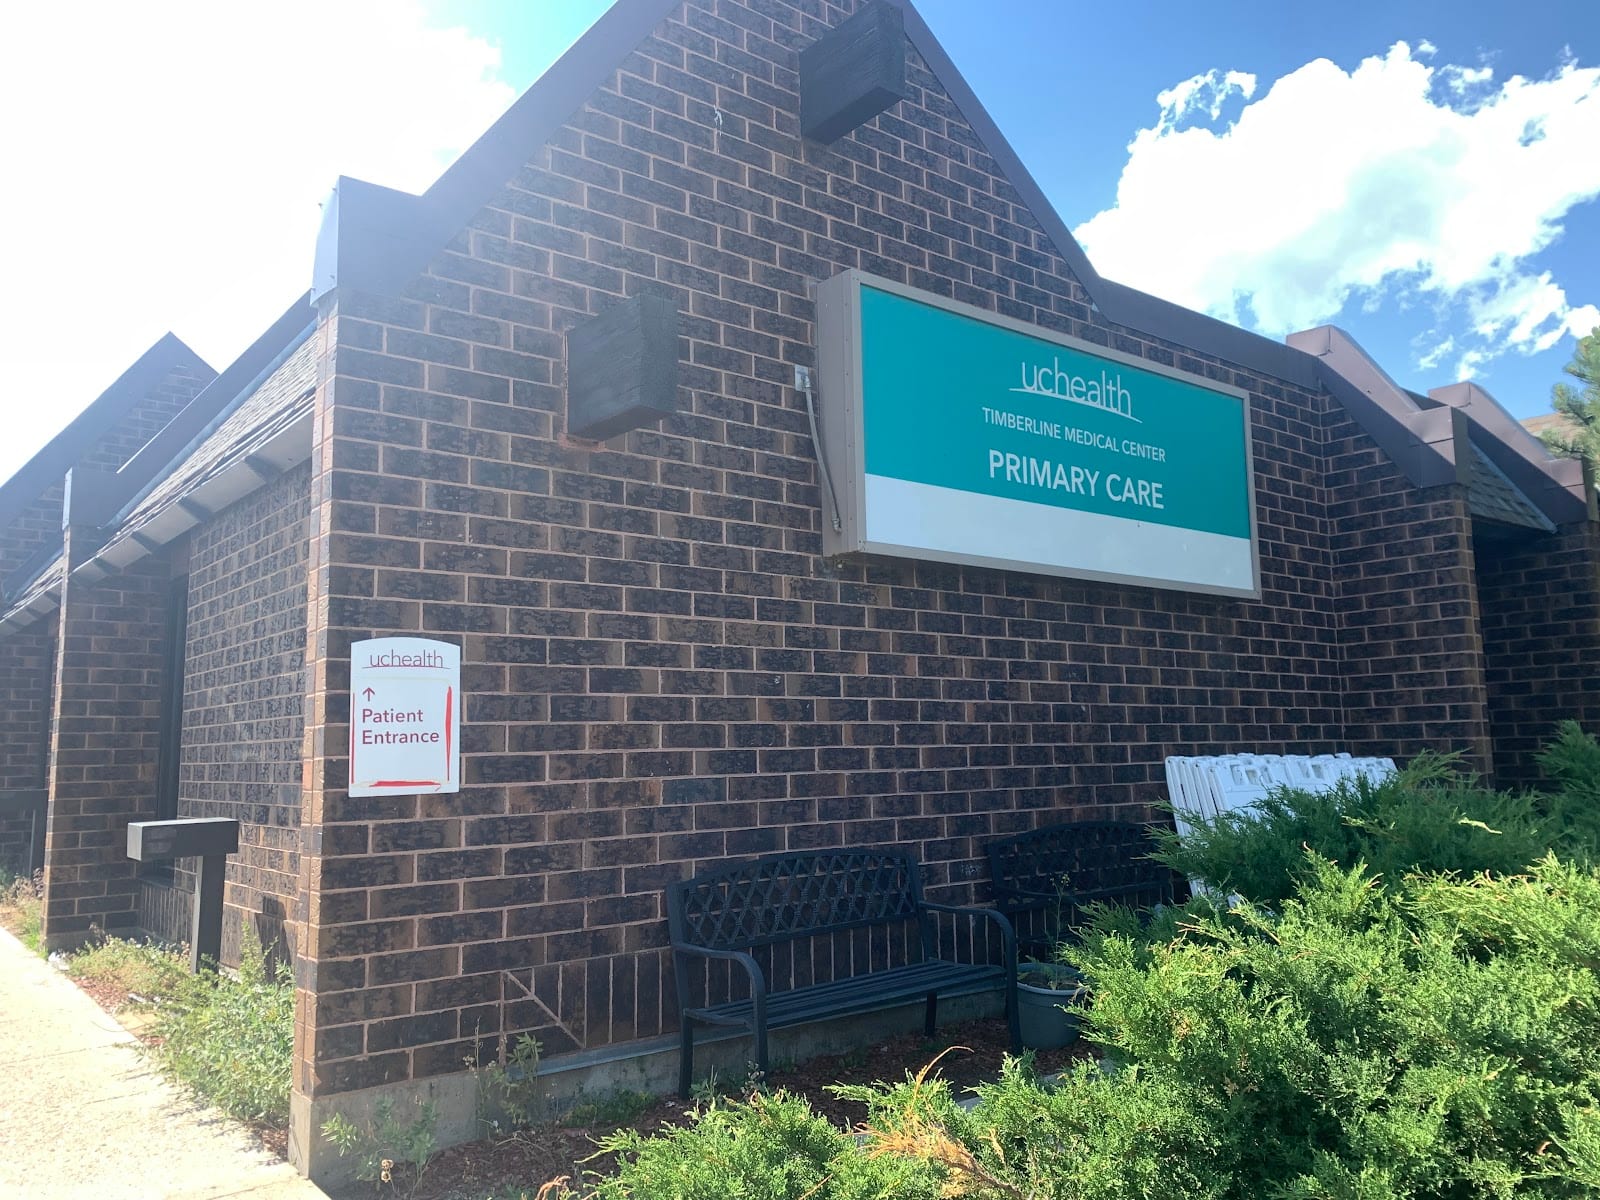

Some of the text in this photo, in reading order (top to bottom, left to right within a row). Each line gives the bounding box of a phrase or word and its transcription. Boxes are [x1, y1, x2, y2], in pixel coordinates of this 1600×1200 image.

[1021, 356, 1132, 418] uchealth
[982, 406, 1166, 462] TIMBERLINE MEDICAL CENTER
[989, 449, 1164, 509] PRIMARY CARE
[369, 649, 443, 668] uchealth
[362, 708, 424, 723] Patient
[362, 730, 440, 744] Entrance
